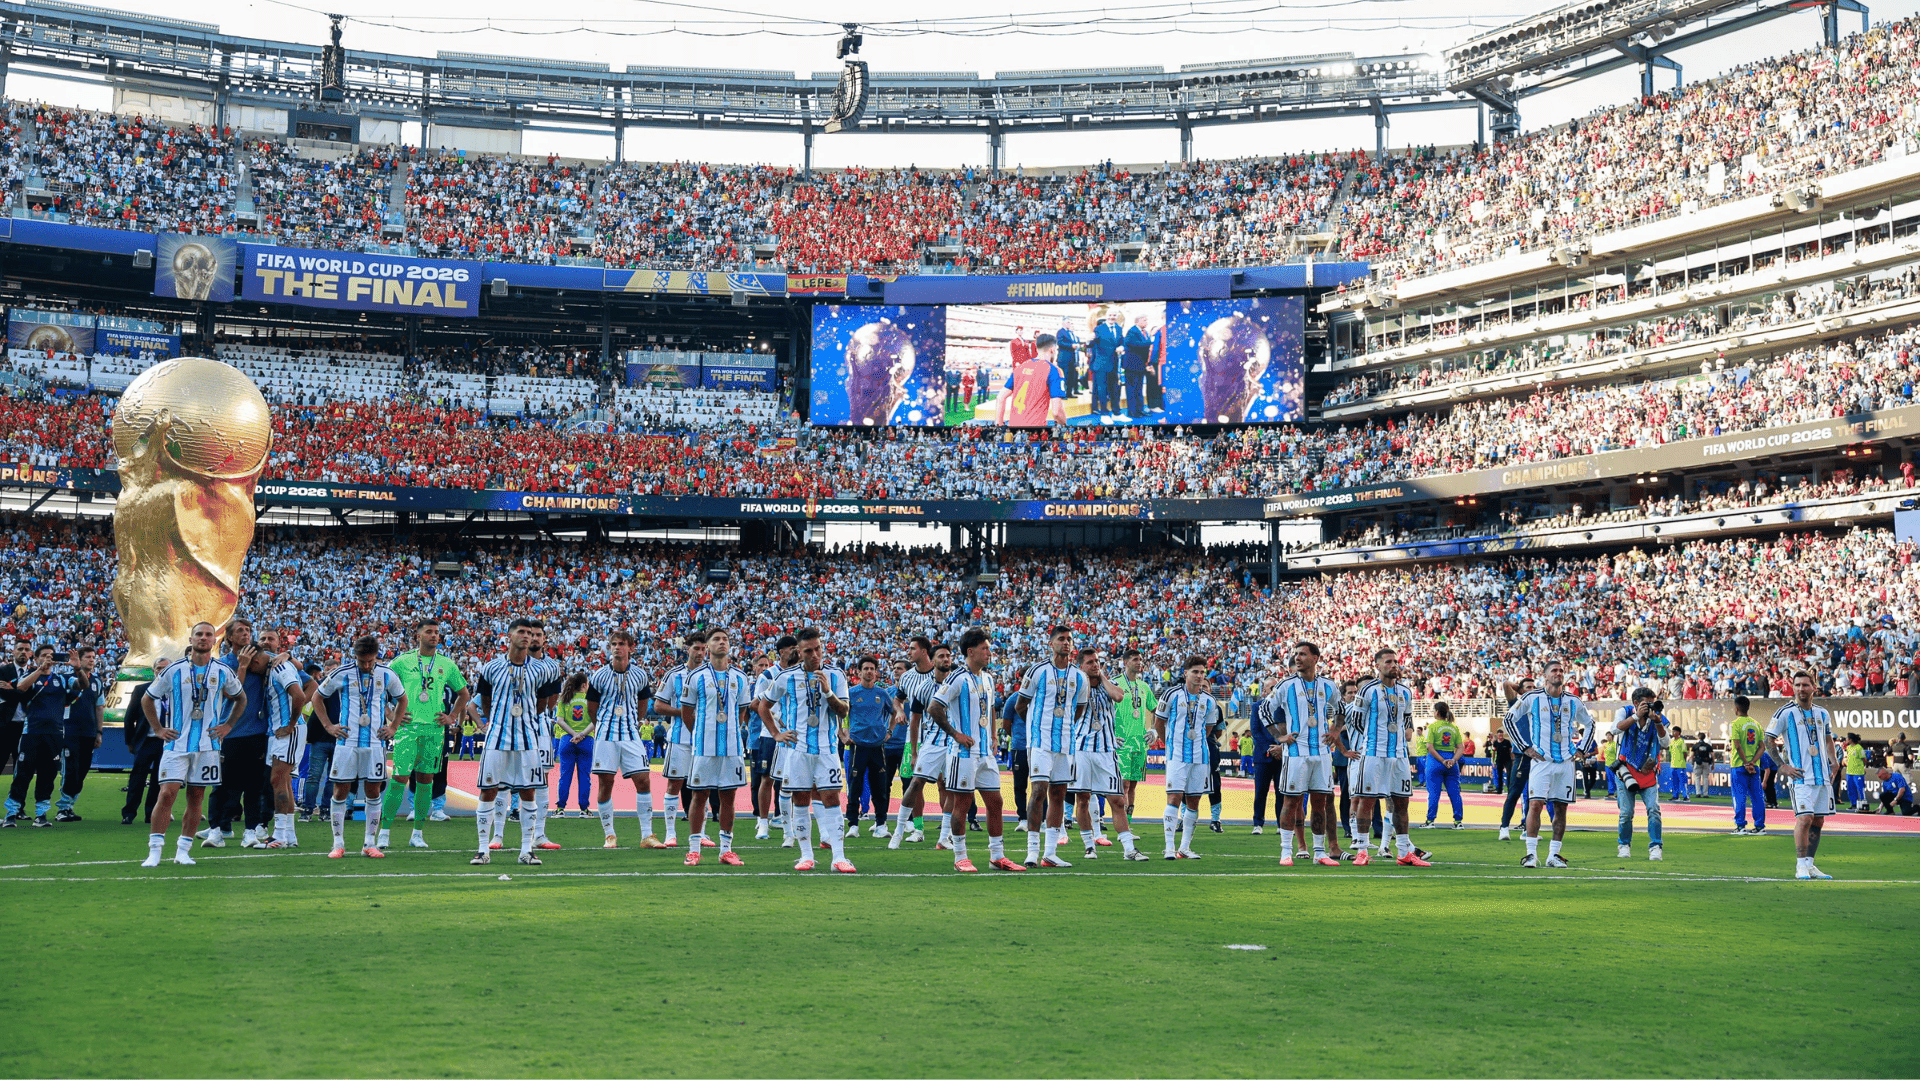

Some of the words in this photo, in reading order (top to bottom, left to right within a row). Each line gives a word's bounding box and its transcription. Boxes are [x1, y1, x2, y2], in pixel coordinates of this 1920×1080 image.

[257, 253, 296, 270] FIFA
[299, 257, 365, 275] WORLD
[368, 263, 404, 277] CUP
[406, 265, 469, 282] 2026
[256, 269, 339, 300] THE
[347, 276, 468, 309] FINAL
[802, 277, 832, 288] LEPE
[1007, 281, 1104, 298] #FIFAWorldCup
[107, 338, 131, 347] THE
[133, 340, 169, 350] FINAL
[711, 373, 733, 381] THE
[734, 374, 766, 382] FINAL
[1013, 381, 1029, 414] 4
[1703, 443, 1726, 456] FIFA
[1727, 438, 1767, 455] WORLD
[1767, 434, 1790, 447] CUP
[1791, 427, 1833, 443] 2026
[1836, 421, 1864, 437] THE
[1865, 416, 1907, 433] FINAL
[1502, 461, 1588, 485] CHAMPIONS
[264, 485, 287, 495] CUP
[288, 487, 327, 497] 2026
[330, 489, 357, 499] THE
[358, 490, 396, 500] FINAL
[1266, 503, 1282, 512] FIFA
[1282, 499, 1309, 511] WORLD
[1309, 497, 1325, 507] CUP
[1325, 494, 1353, 505] 2026
[1355, 492, 1374, 501] THE
[1375, 487, 1403, 499] FINAL
[522, 495, 619, 510] CHAMPIONS
[740, 503, 763, 512] FIFA
[763, 503, 800, 513] WORLD
[823, 504, 859, 514] 2026
[862, 505, 887, 514] THE
[888, 506, 924, 515] FINAL
[1044, 503, 1140, 516] CHAMPIONS
[1833, 709, 1895, 728] WORLD
[201, 765, 219, 781] 20
[375, 762, 383, 777] 3
[530, 767, 542, 782] 14
[735, 766, 742, 781] 4
[829, 768, 843, 784] 22
[1109, 776, 1117, 790] 11
[1401, 779, 1411, 793] 19
[1566, 786, 1572, 798] 7
